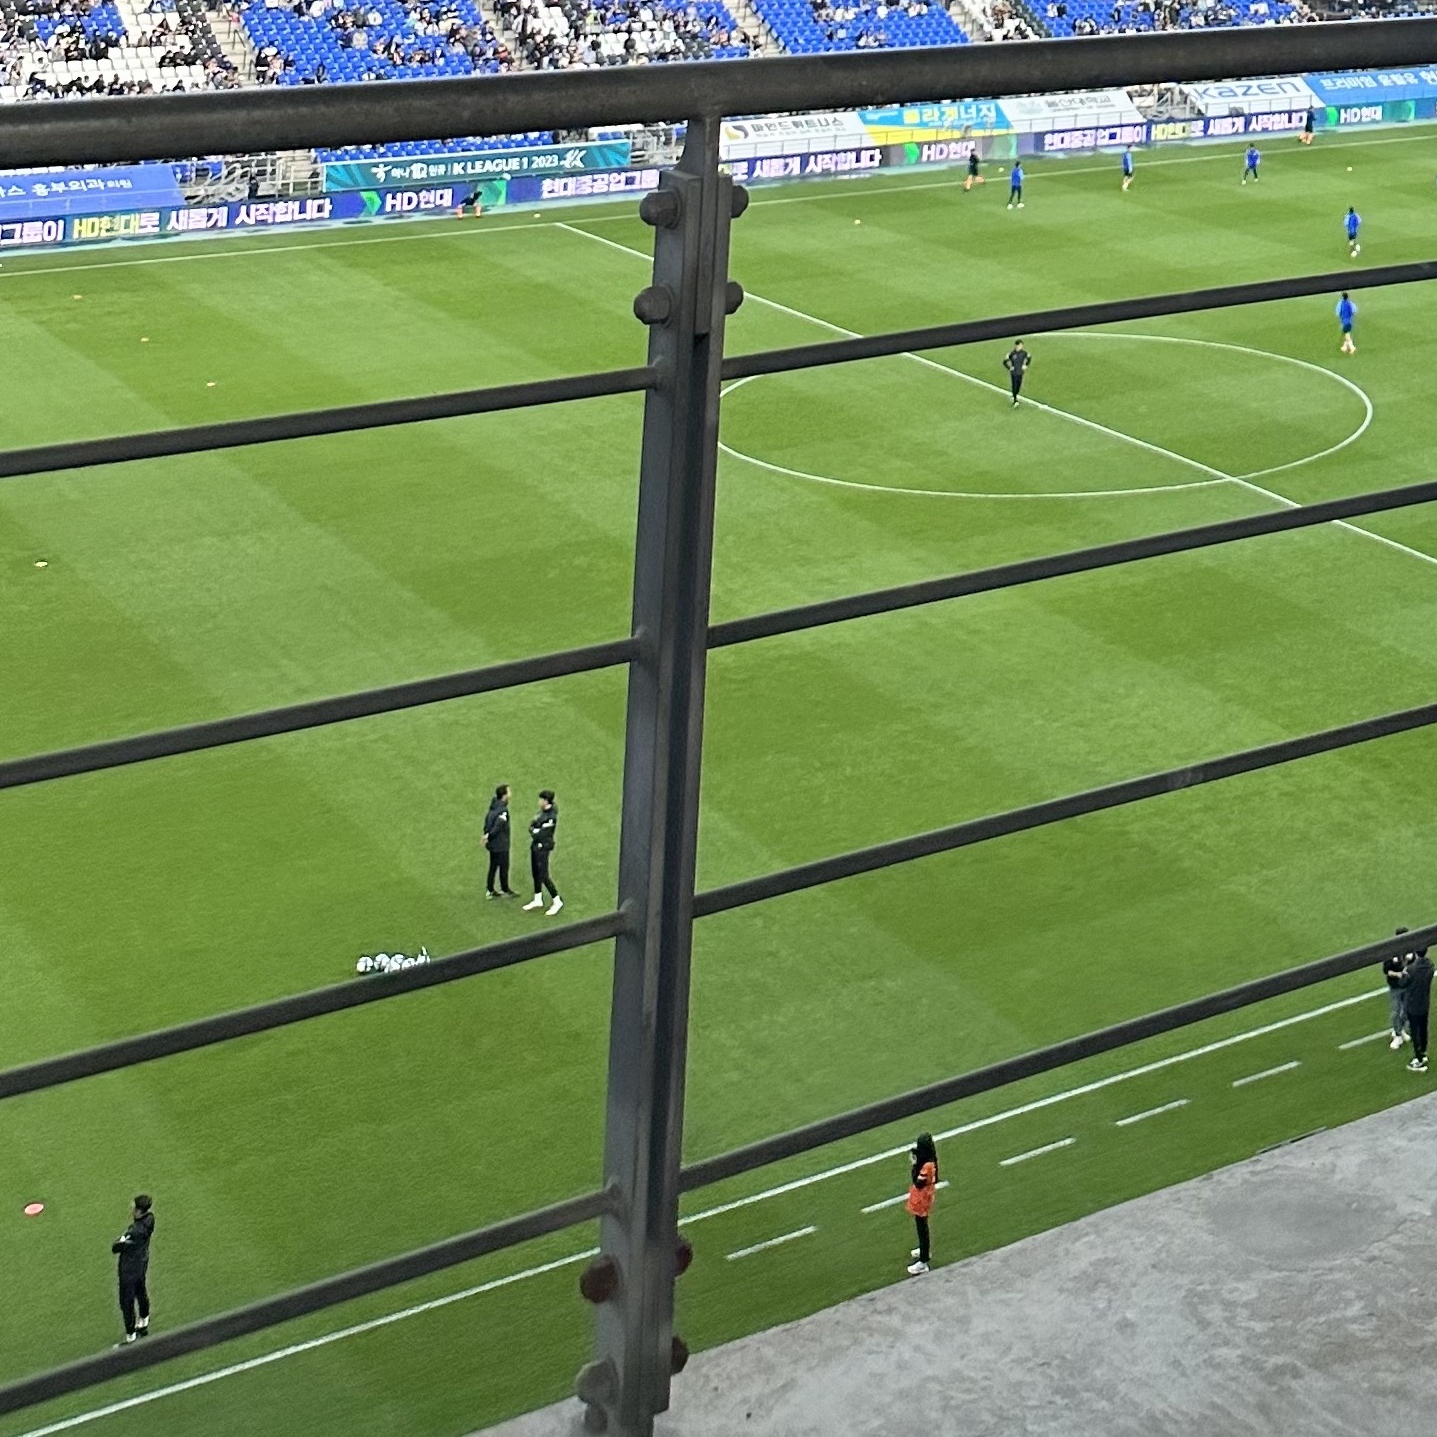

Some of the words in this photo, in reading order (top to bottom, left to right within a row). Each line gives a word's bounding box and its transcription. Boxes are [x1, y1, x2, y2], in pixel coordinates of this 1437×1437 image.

[453, 162, 465, 175] K
[467, 157, 520, 174] LEAGUE
[531, 155, 559, 169] 2023
[541, 169, 660, 198] 현대중공업그룹
[385, 188, 453, 212] HD현대
[0, 219, 64, 245] 그룹이
[73, 212, 160, 239] HD현대로
[167, 206, 228, 231] 새롭게
[235, 198, 332, 226] 시작합니다
